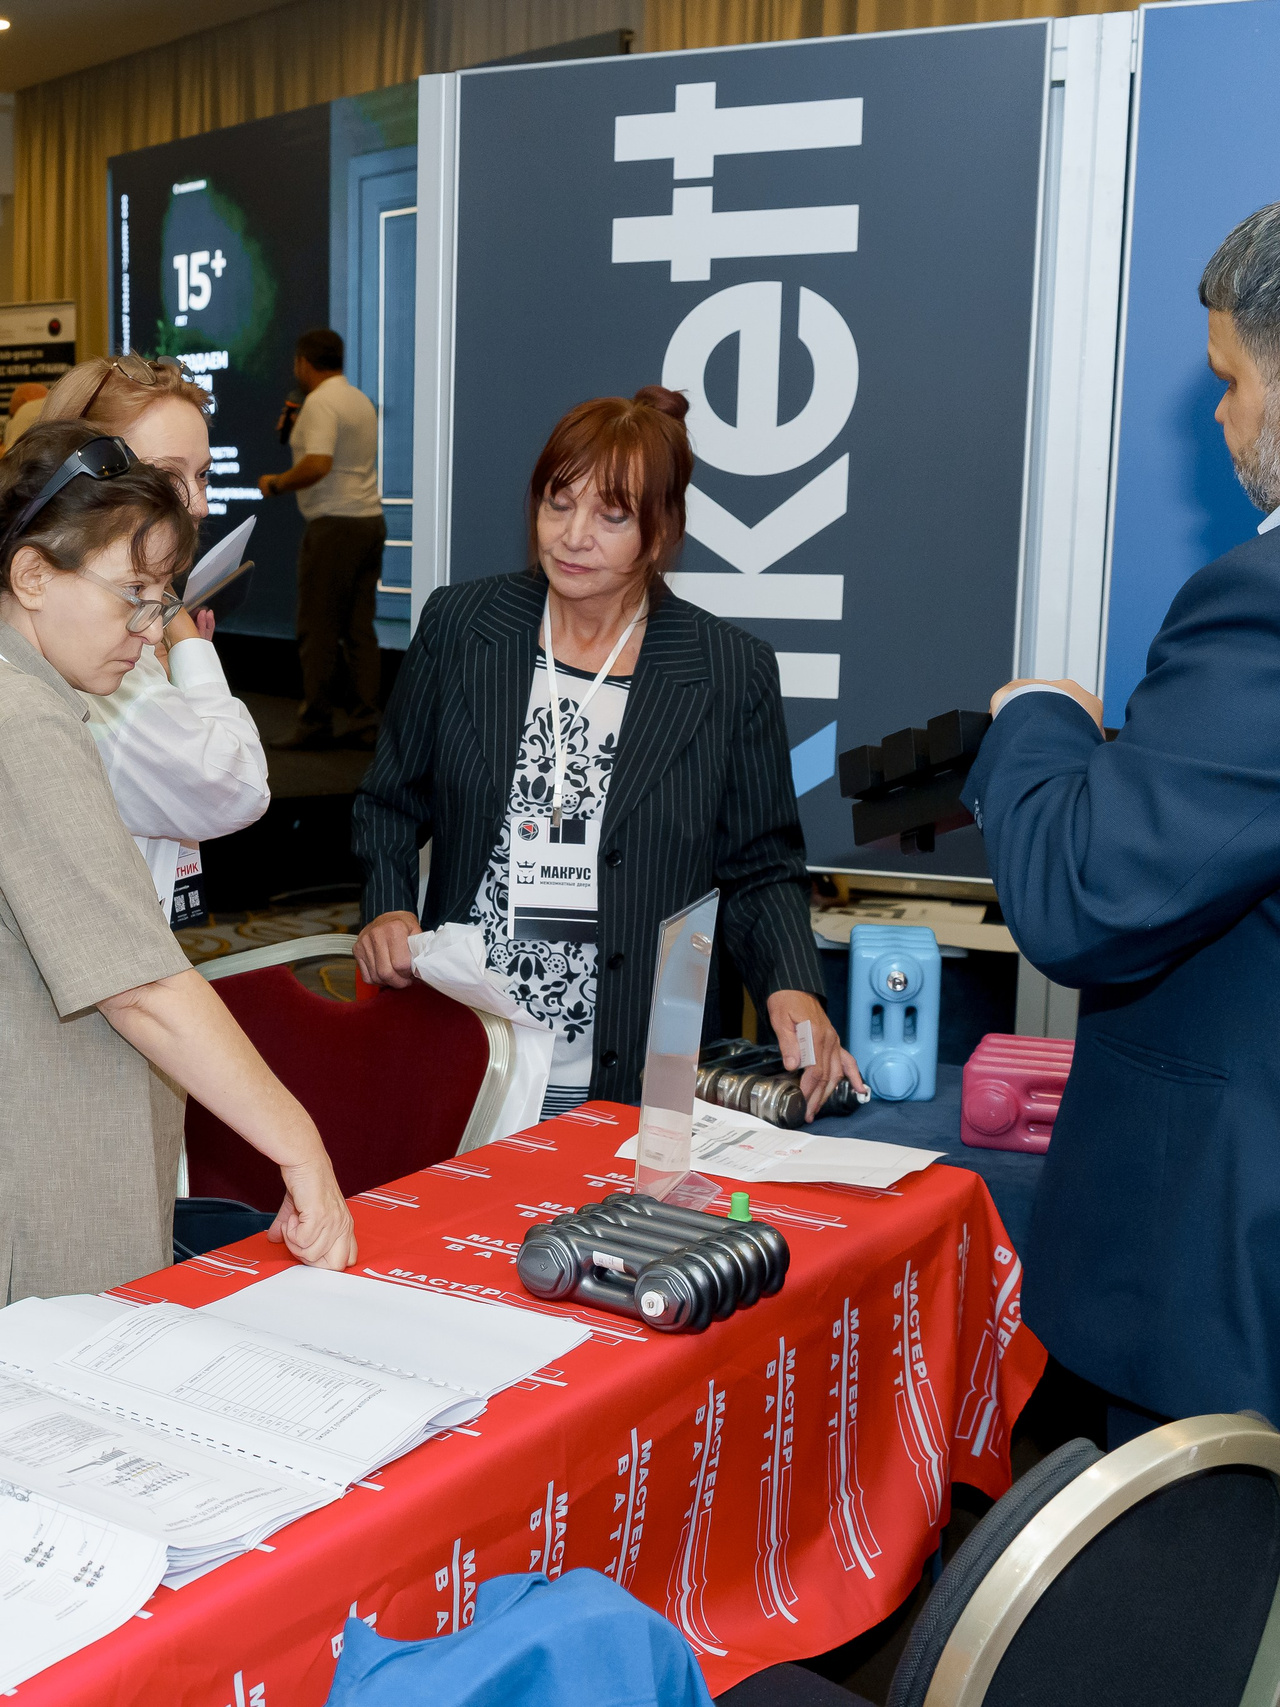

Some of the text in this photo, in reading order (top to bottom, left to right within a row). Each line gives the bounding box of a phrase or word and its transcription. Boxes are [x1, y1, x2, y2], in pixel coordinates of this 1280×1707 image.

[173, 249, 226, 312] 15+
[540, 865, 591, 881] МАКРУС
[388, 1267, 502, 1298] МАСТЕР
[910, 1270, 928, 1379] МАСТЕР
[782, 1347, 796, 1463] МАСТЕР
[847, 1307, 860, 1420] МАСТЕР
[629, 1438, 653, 1562] МАСТЕР
[702, 1389, 726, 1507] МАСТЕР
